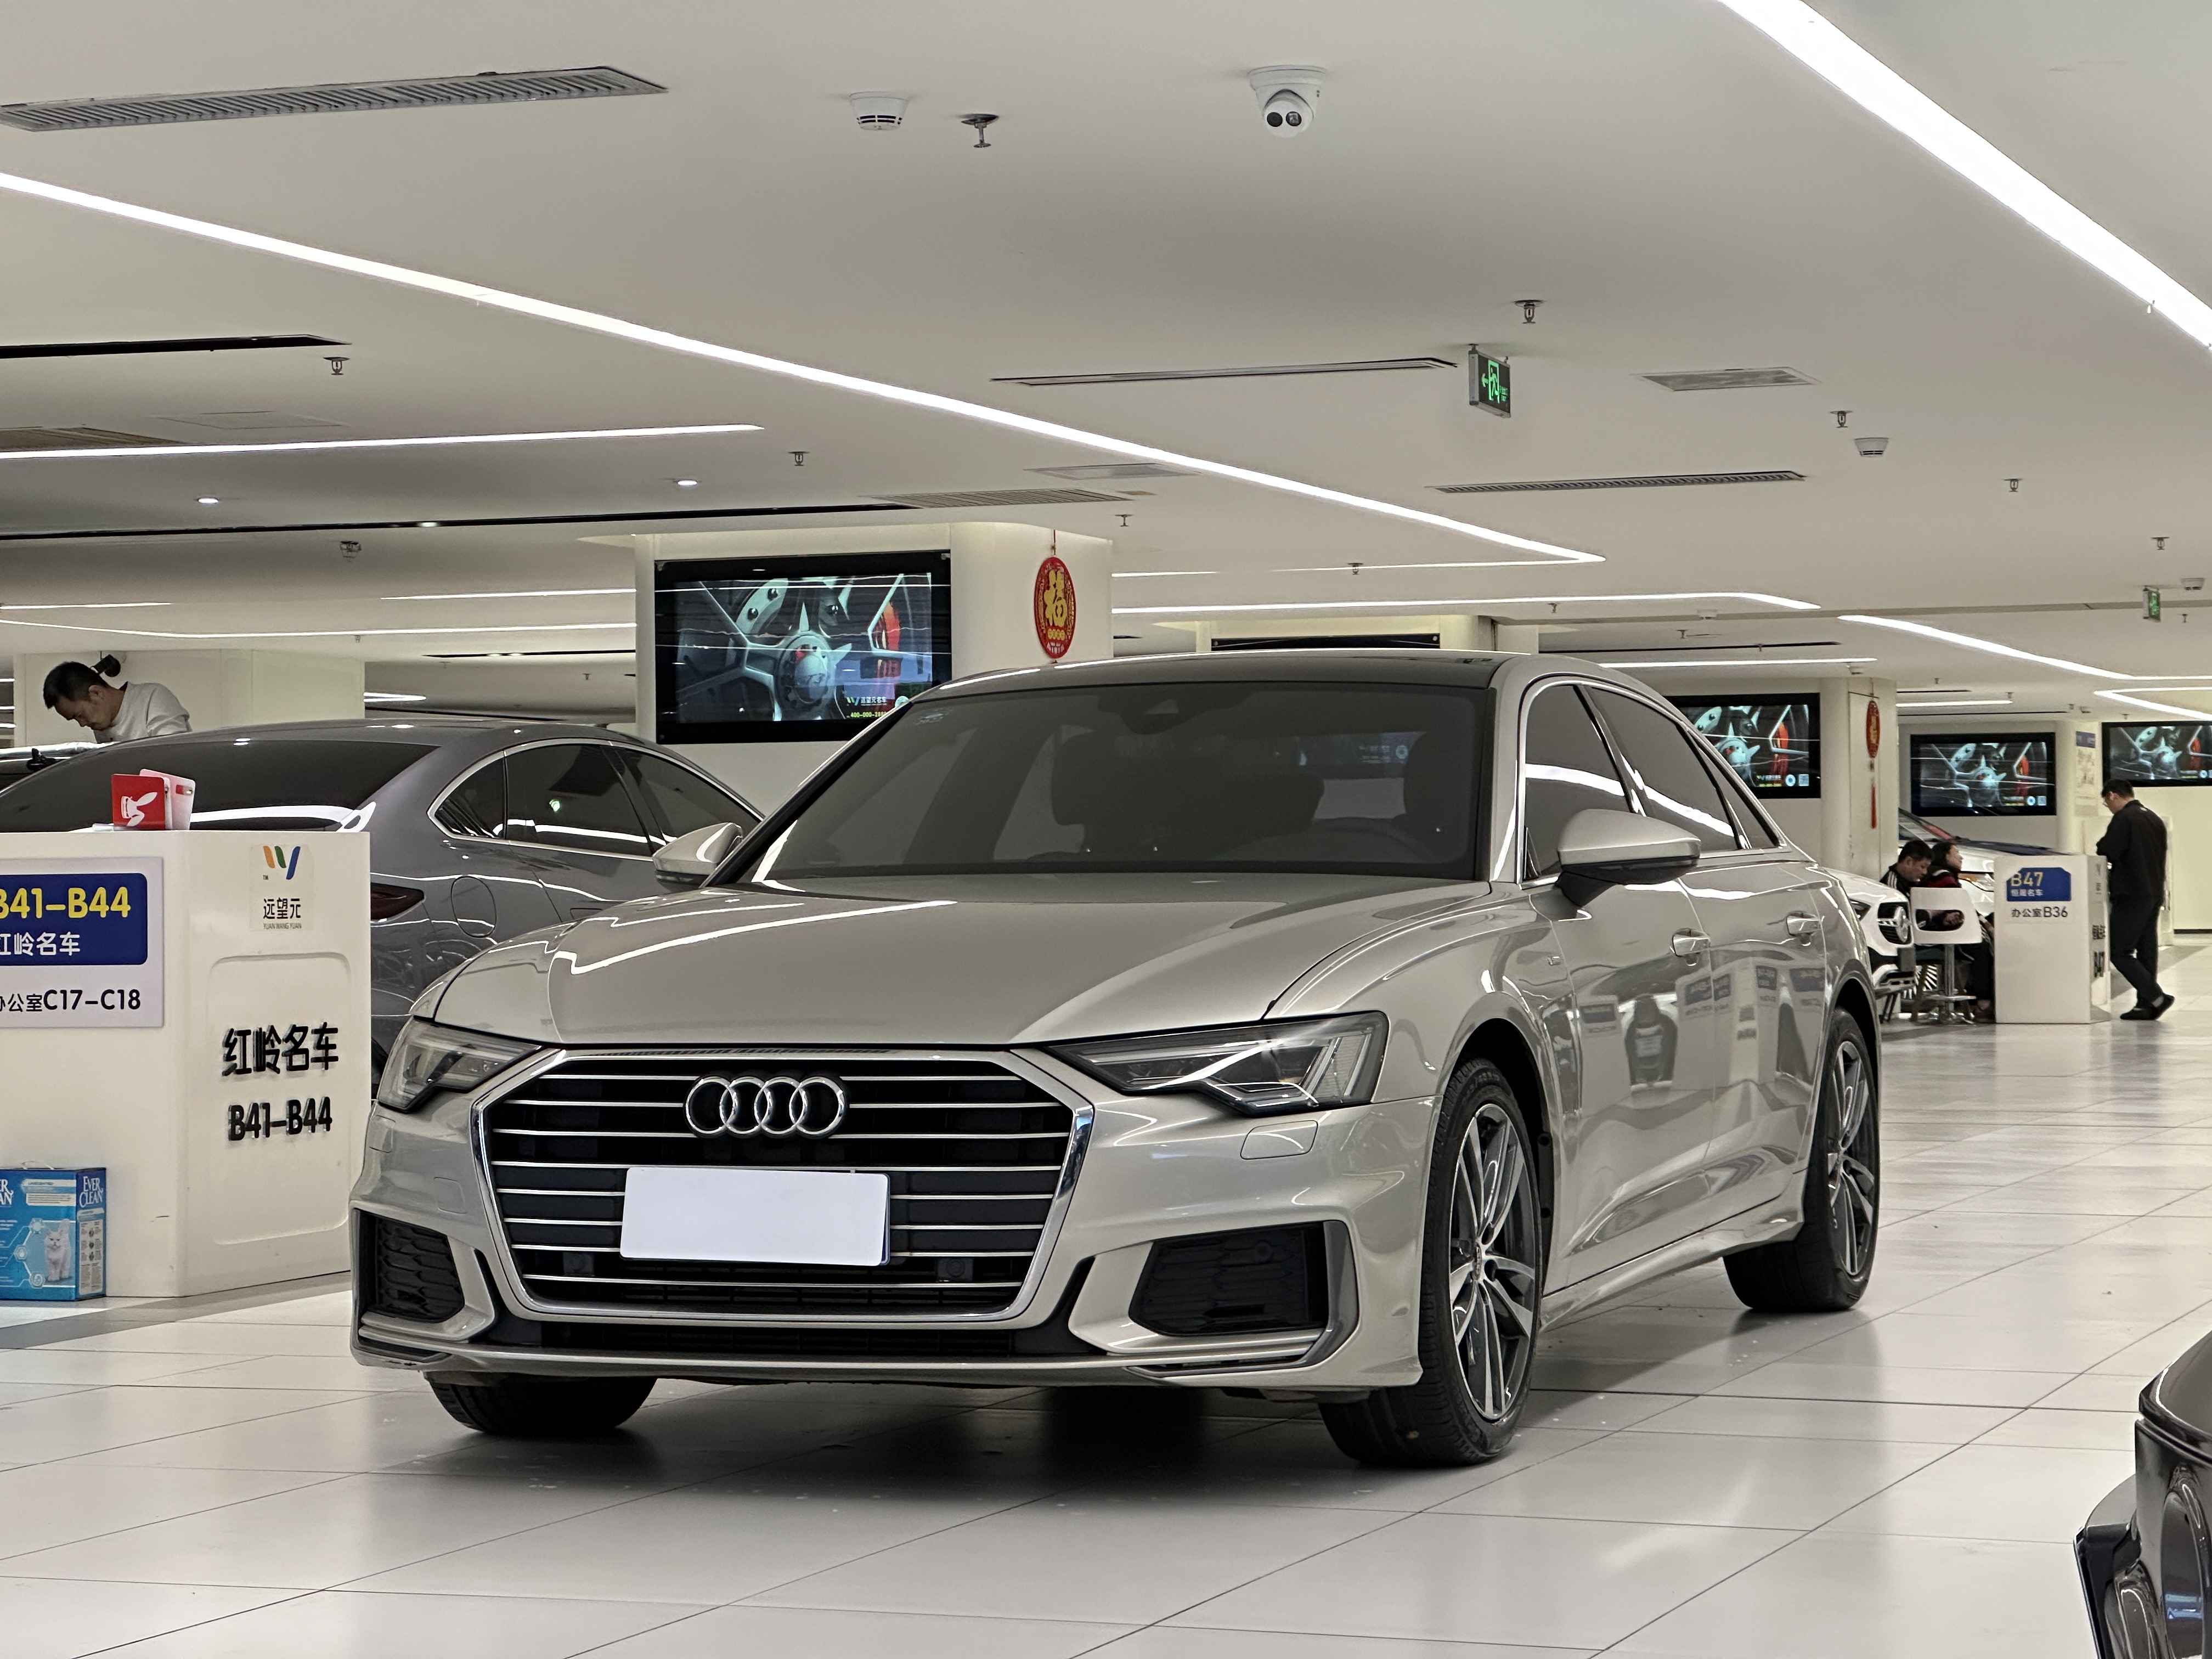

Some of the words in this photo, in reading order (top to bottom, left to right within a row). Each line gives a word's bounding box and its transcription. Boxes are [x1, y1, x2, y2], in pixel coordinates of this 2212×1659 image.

[2011, 872, 2043, 887] B47
[263, 897, 301, 919] 远望元
[2012, 906, 2068, 917] 办公室B36
[222, 1022, 338, 1076] 红岭名车
[228, 1097, 332, 1141] B41-B44
[83, 1176, 104, 1193] EVER
[79, 1191, 103, 1207] CLEAN
